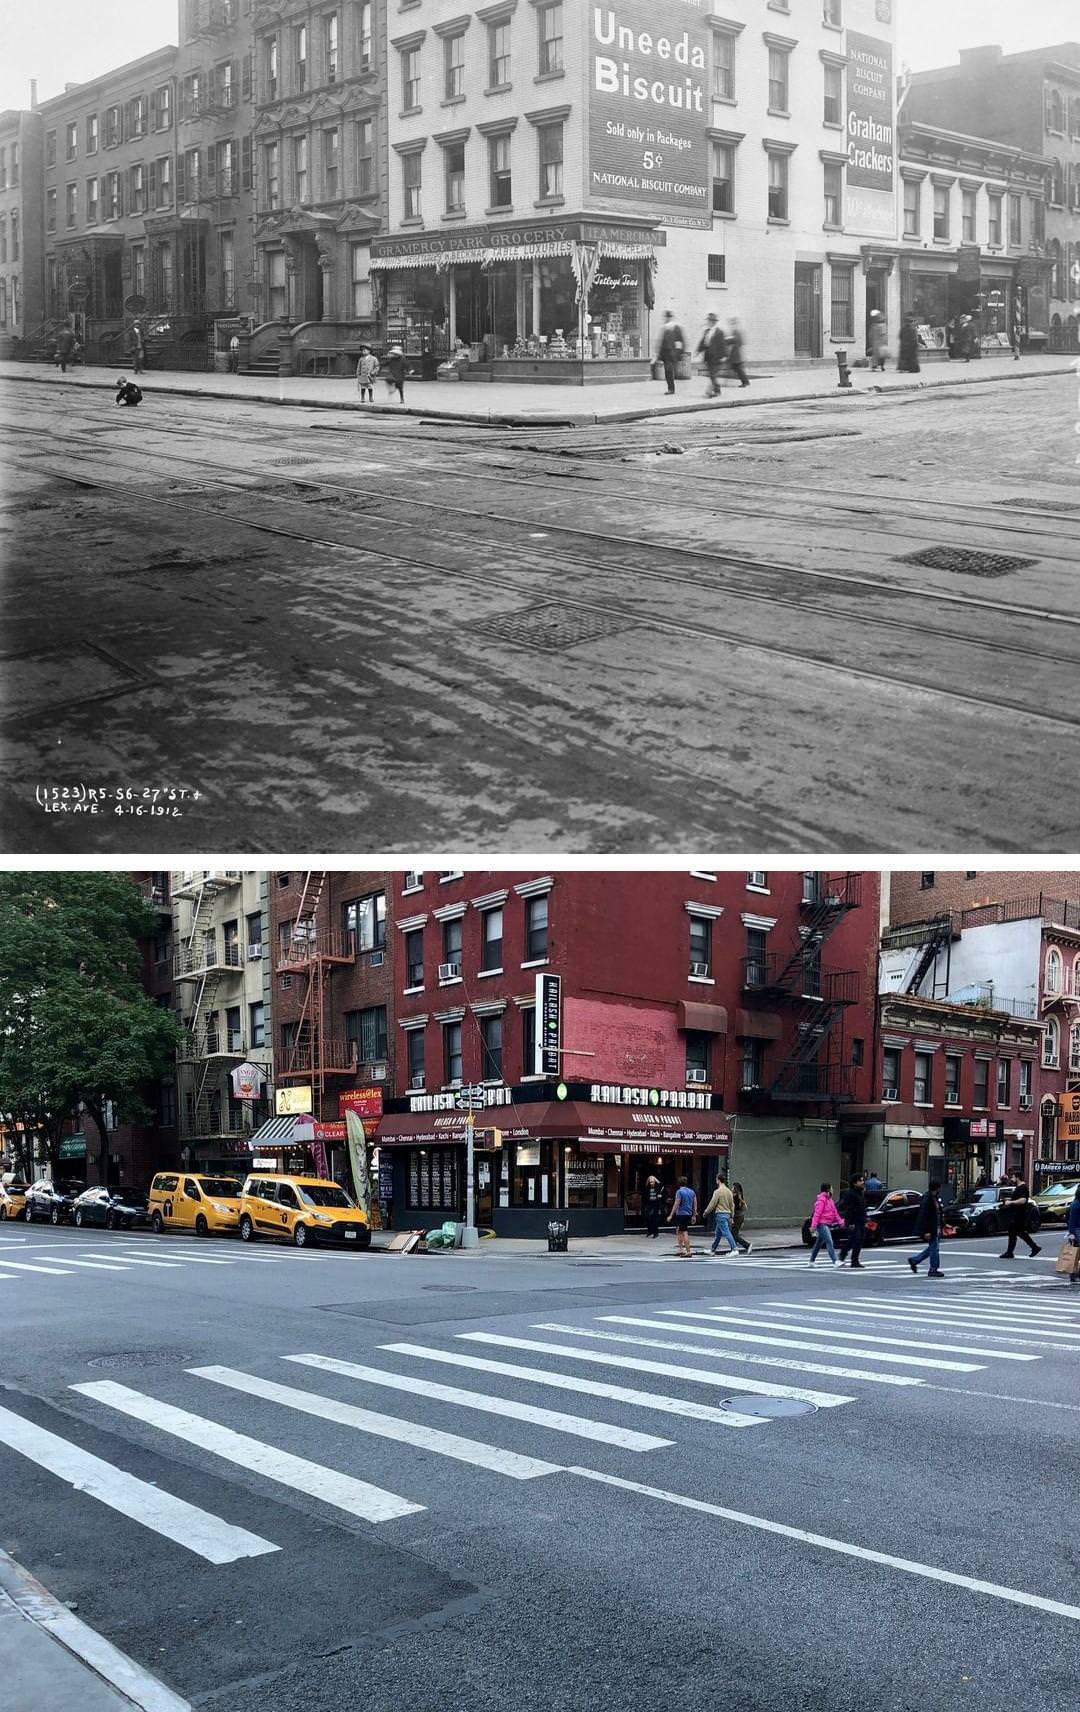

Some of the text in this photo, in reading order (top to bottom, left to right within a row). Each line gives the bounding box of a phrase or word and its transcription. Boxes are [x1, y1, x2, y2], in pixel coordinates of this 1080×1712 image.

[594, 8, 705, 69] Uneeda
[850, 49, 887, 69] NATIONAL
[595, 56, 703, 112] Biscuit
[856, 67, 883, 84] BISCUIT
[853, 83, 886, 100] COMPANY
[606, 121, 692, 150] Sold only in Packages
[848, 111, 892, 144] Graham
[848, 142, 892, 172] Crackers
[593, 172, 707, 197] NATIONAL BISCUIT COMPANY
[379, 240, 446, 257] GRAMERCY
[450, 236, 487, 250] PARK
[490, 227, 568, 246] GROCERY
[586, 226, 662, 244] TEA MERCHANT
[524, 240, 572, 255] LUXURIES
[548, 982, 558, 1019] KAILASH
[339, 1088, 382, 1101] wireless@lex
[410, 1093, 455, 1112] KAILASH
[591, 1084, 712, 1110] KAILASH PARBAT
[398, 1134, 413, 1142] Chennai
[513, 1128, 529, 1136] London
[588, 1127, 604, 1135] Mumbai
[607, 1128, 623, 1136] Chennai
[627, 1129, 647, 1138] Hyderabad
[663, 1131, 681, 1139] Bangalore
[695, 1132, 713, 1140] Singapore
